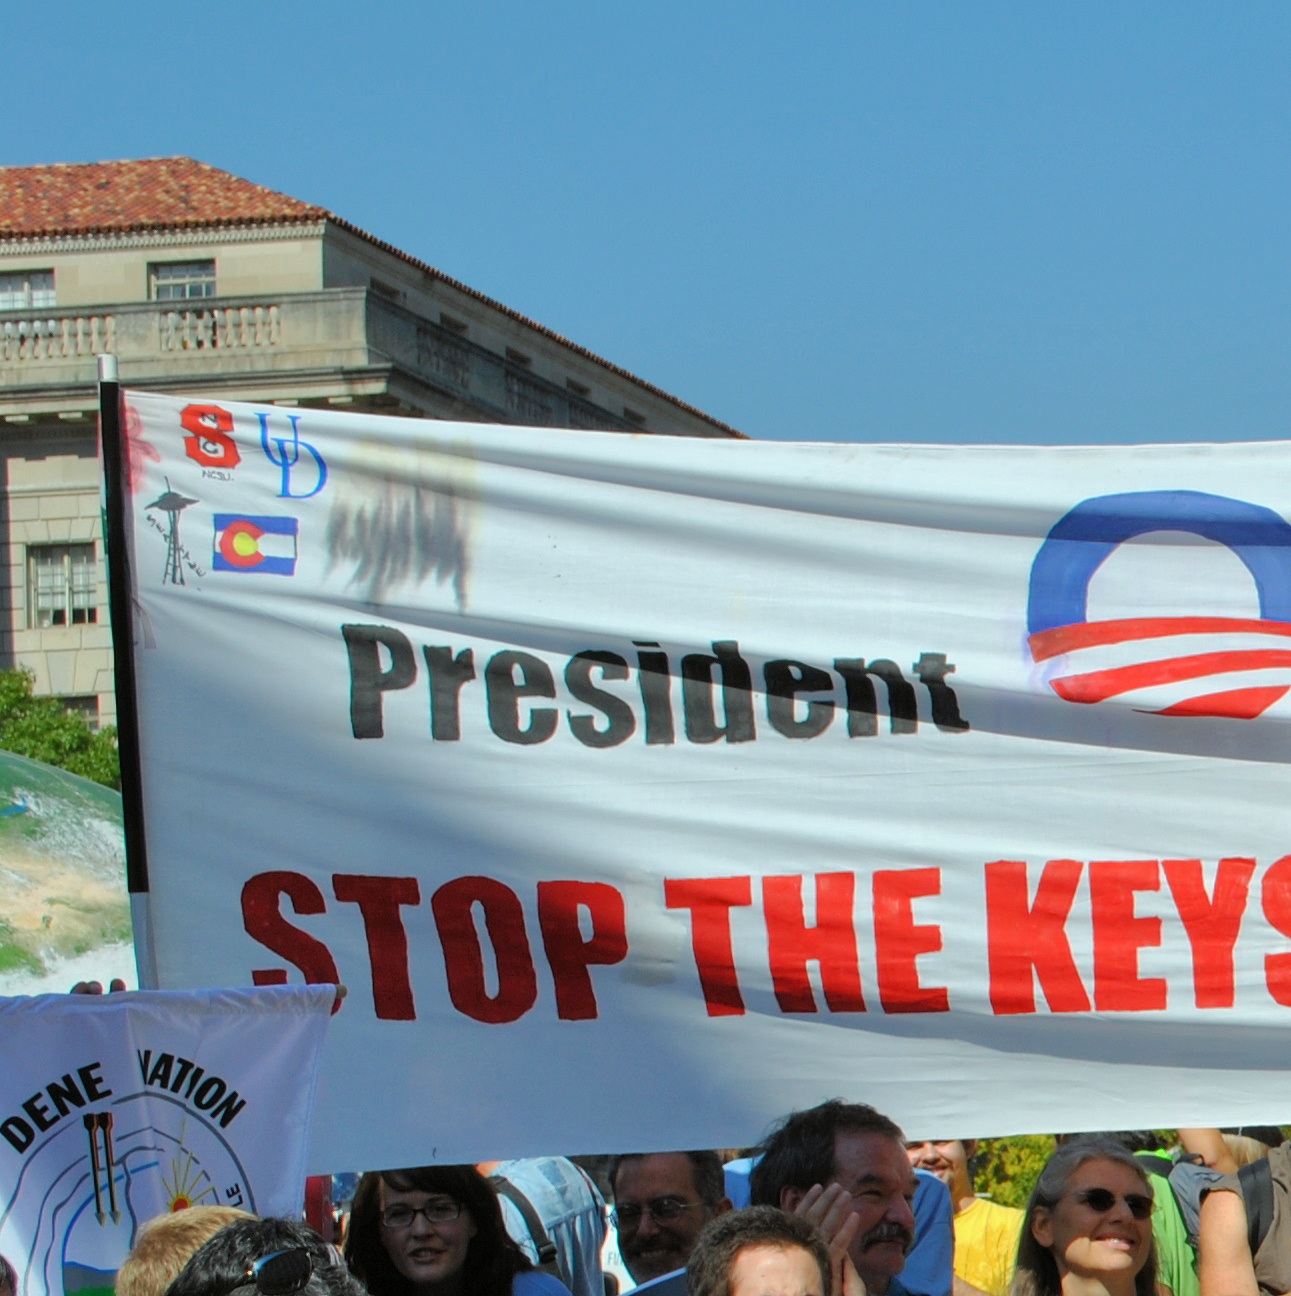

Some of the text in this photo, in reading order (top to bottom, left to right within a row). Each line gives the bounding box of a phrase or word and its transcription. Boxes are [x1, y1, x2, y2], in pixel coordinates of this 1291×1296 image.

[254, 412, 328, 498] UD
[341, 623, 970, 748] President
[240, 870, 628, 1024] STOP
[664, 868, 950, 1017] THE
[0, 1049, 247, 1154] DENE NATION
